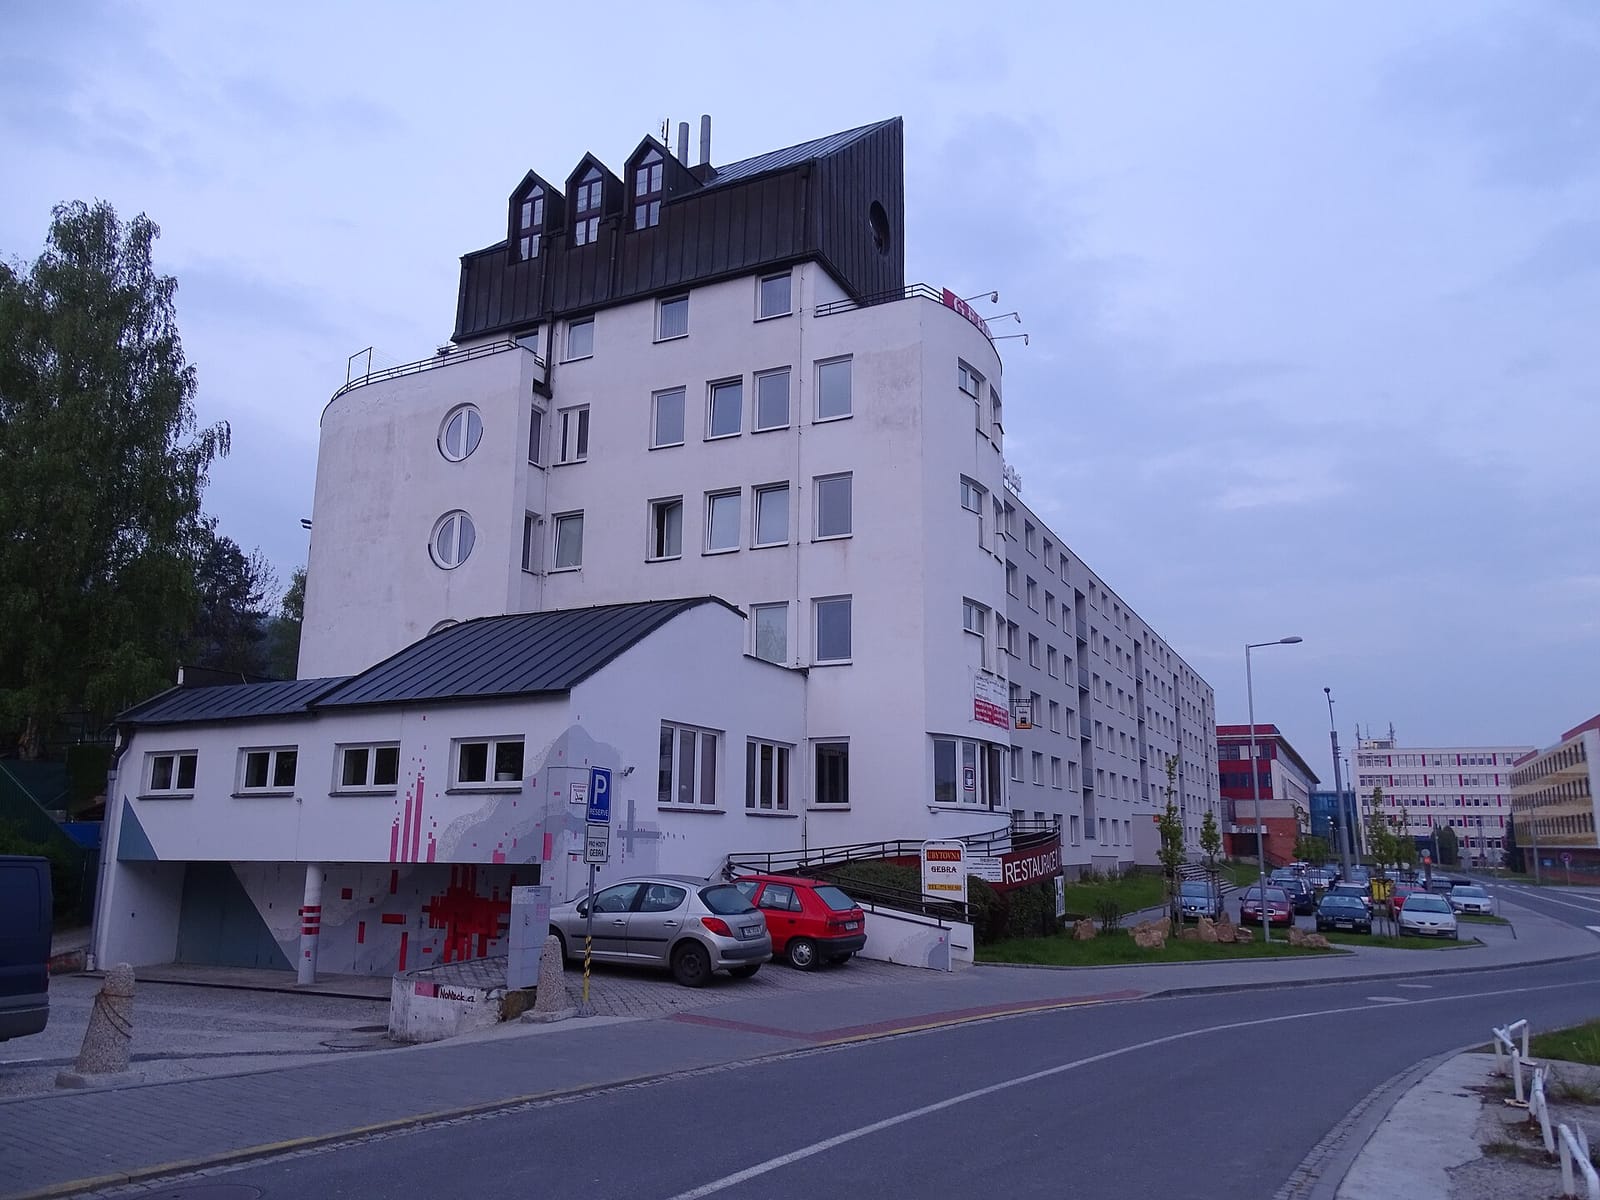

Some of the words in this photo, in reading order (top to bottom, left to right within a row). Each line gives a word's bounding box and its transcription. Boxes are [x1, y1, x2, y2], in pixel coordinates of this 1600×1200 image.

[593, 774, 607, 805] P
[589, 848, 605, 857] GEBRA
[927, 851, 961, 860] UBYTOVNA
[931, 866, 958, 874] GEBRA
[1004, 850, 1056, 885] RESTAURACE
